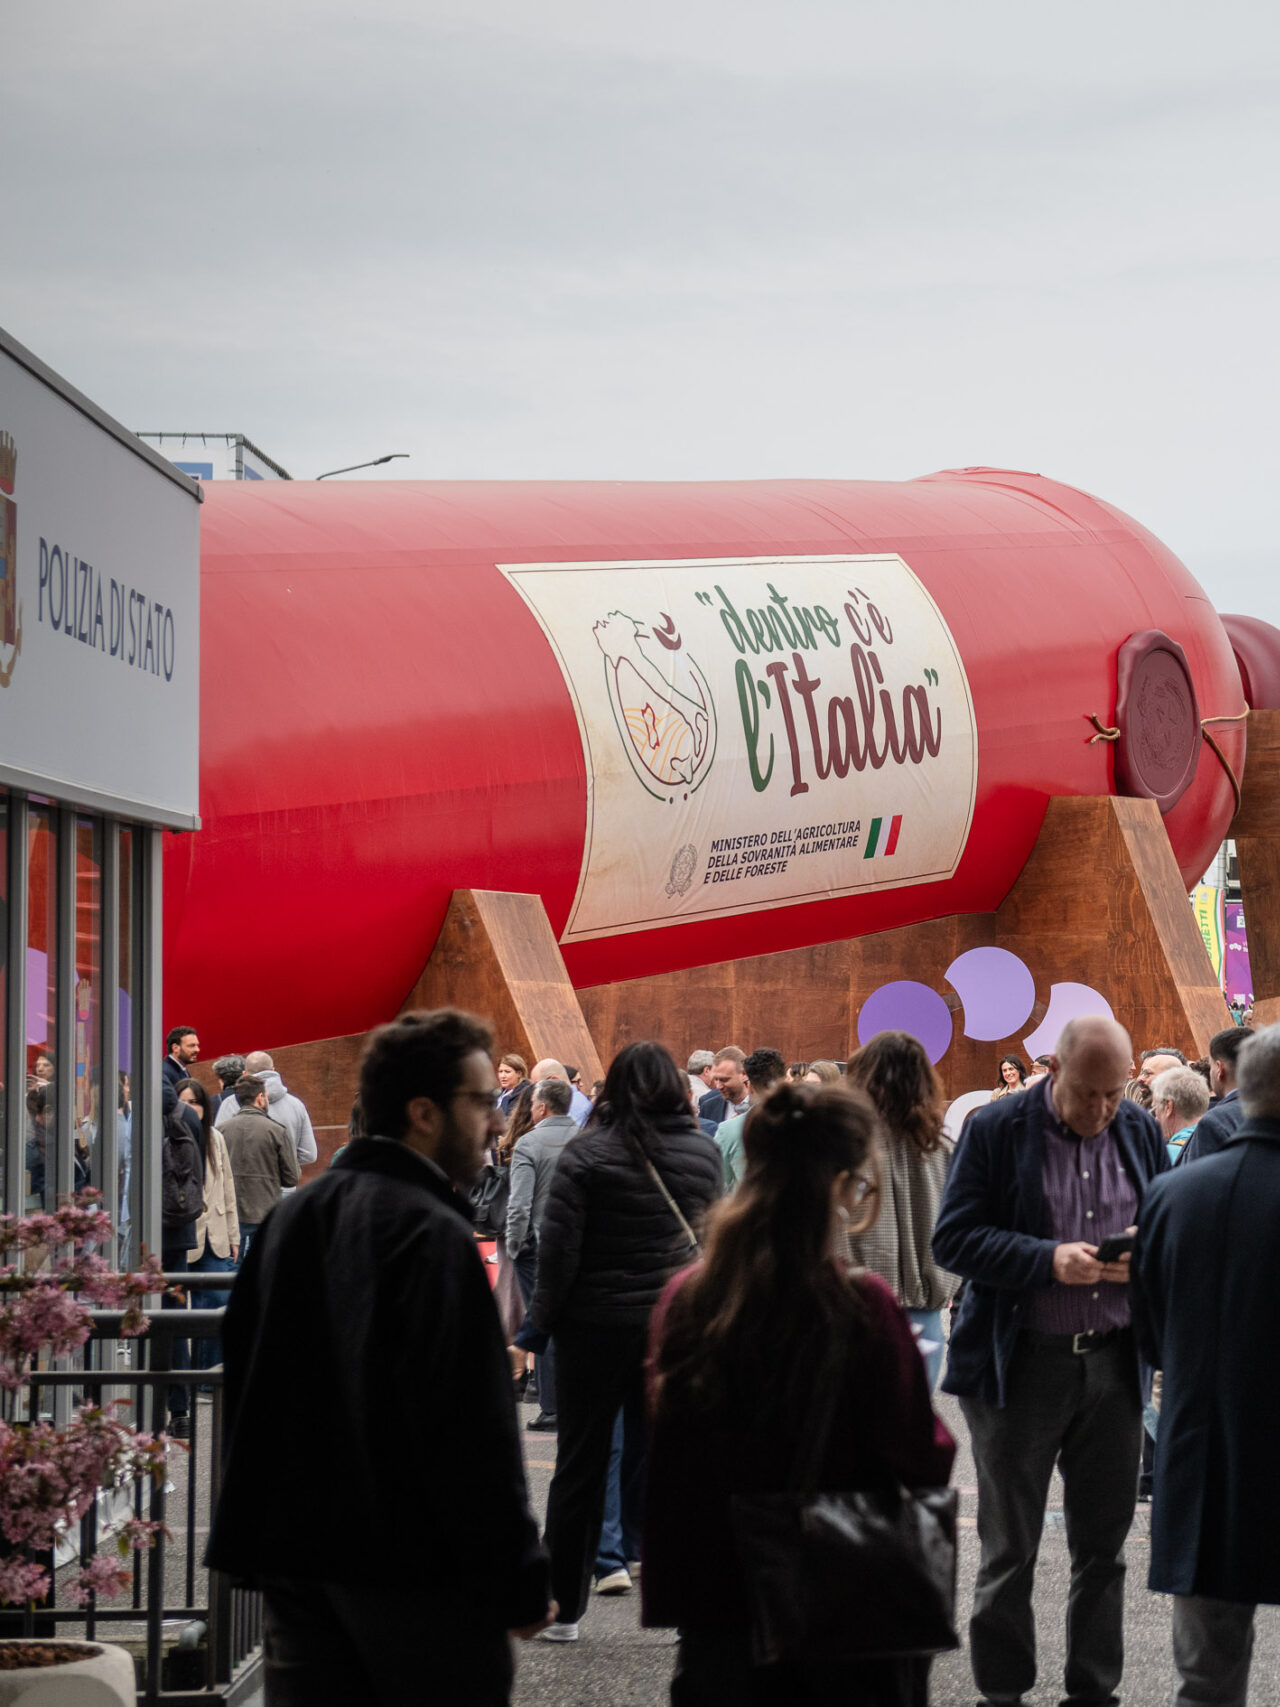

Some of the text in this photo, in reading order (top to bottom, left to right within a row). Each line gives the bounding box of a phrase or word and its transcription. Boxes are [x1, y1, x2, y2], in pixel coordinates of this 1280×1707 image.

[38, 536, 175, 682] POLIZIA DI STATO
[707, 835, 860, 869] DELLA SOVRANITÀ ALIMENTARE
[710, 819, 861, 853] MINISTERO DELL'AGRICOLTURA
[703, 860, 789, 885] E DELLE FORESTE
